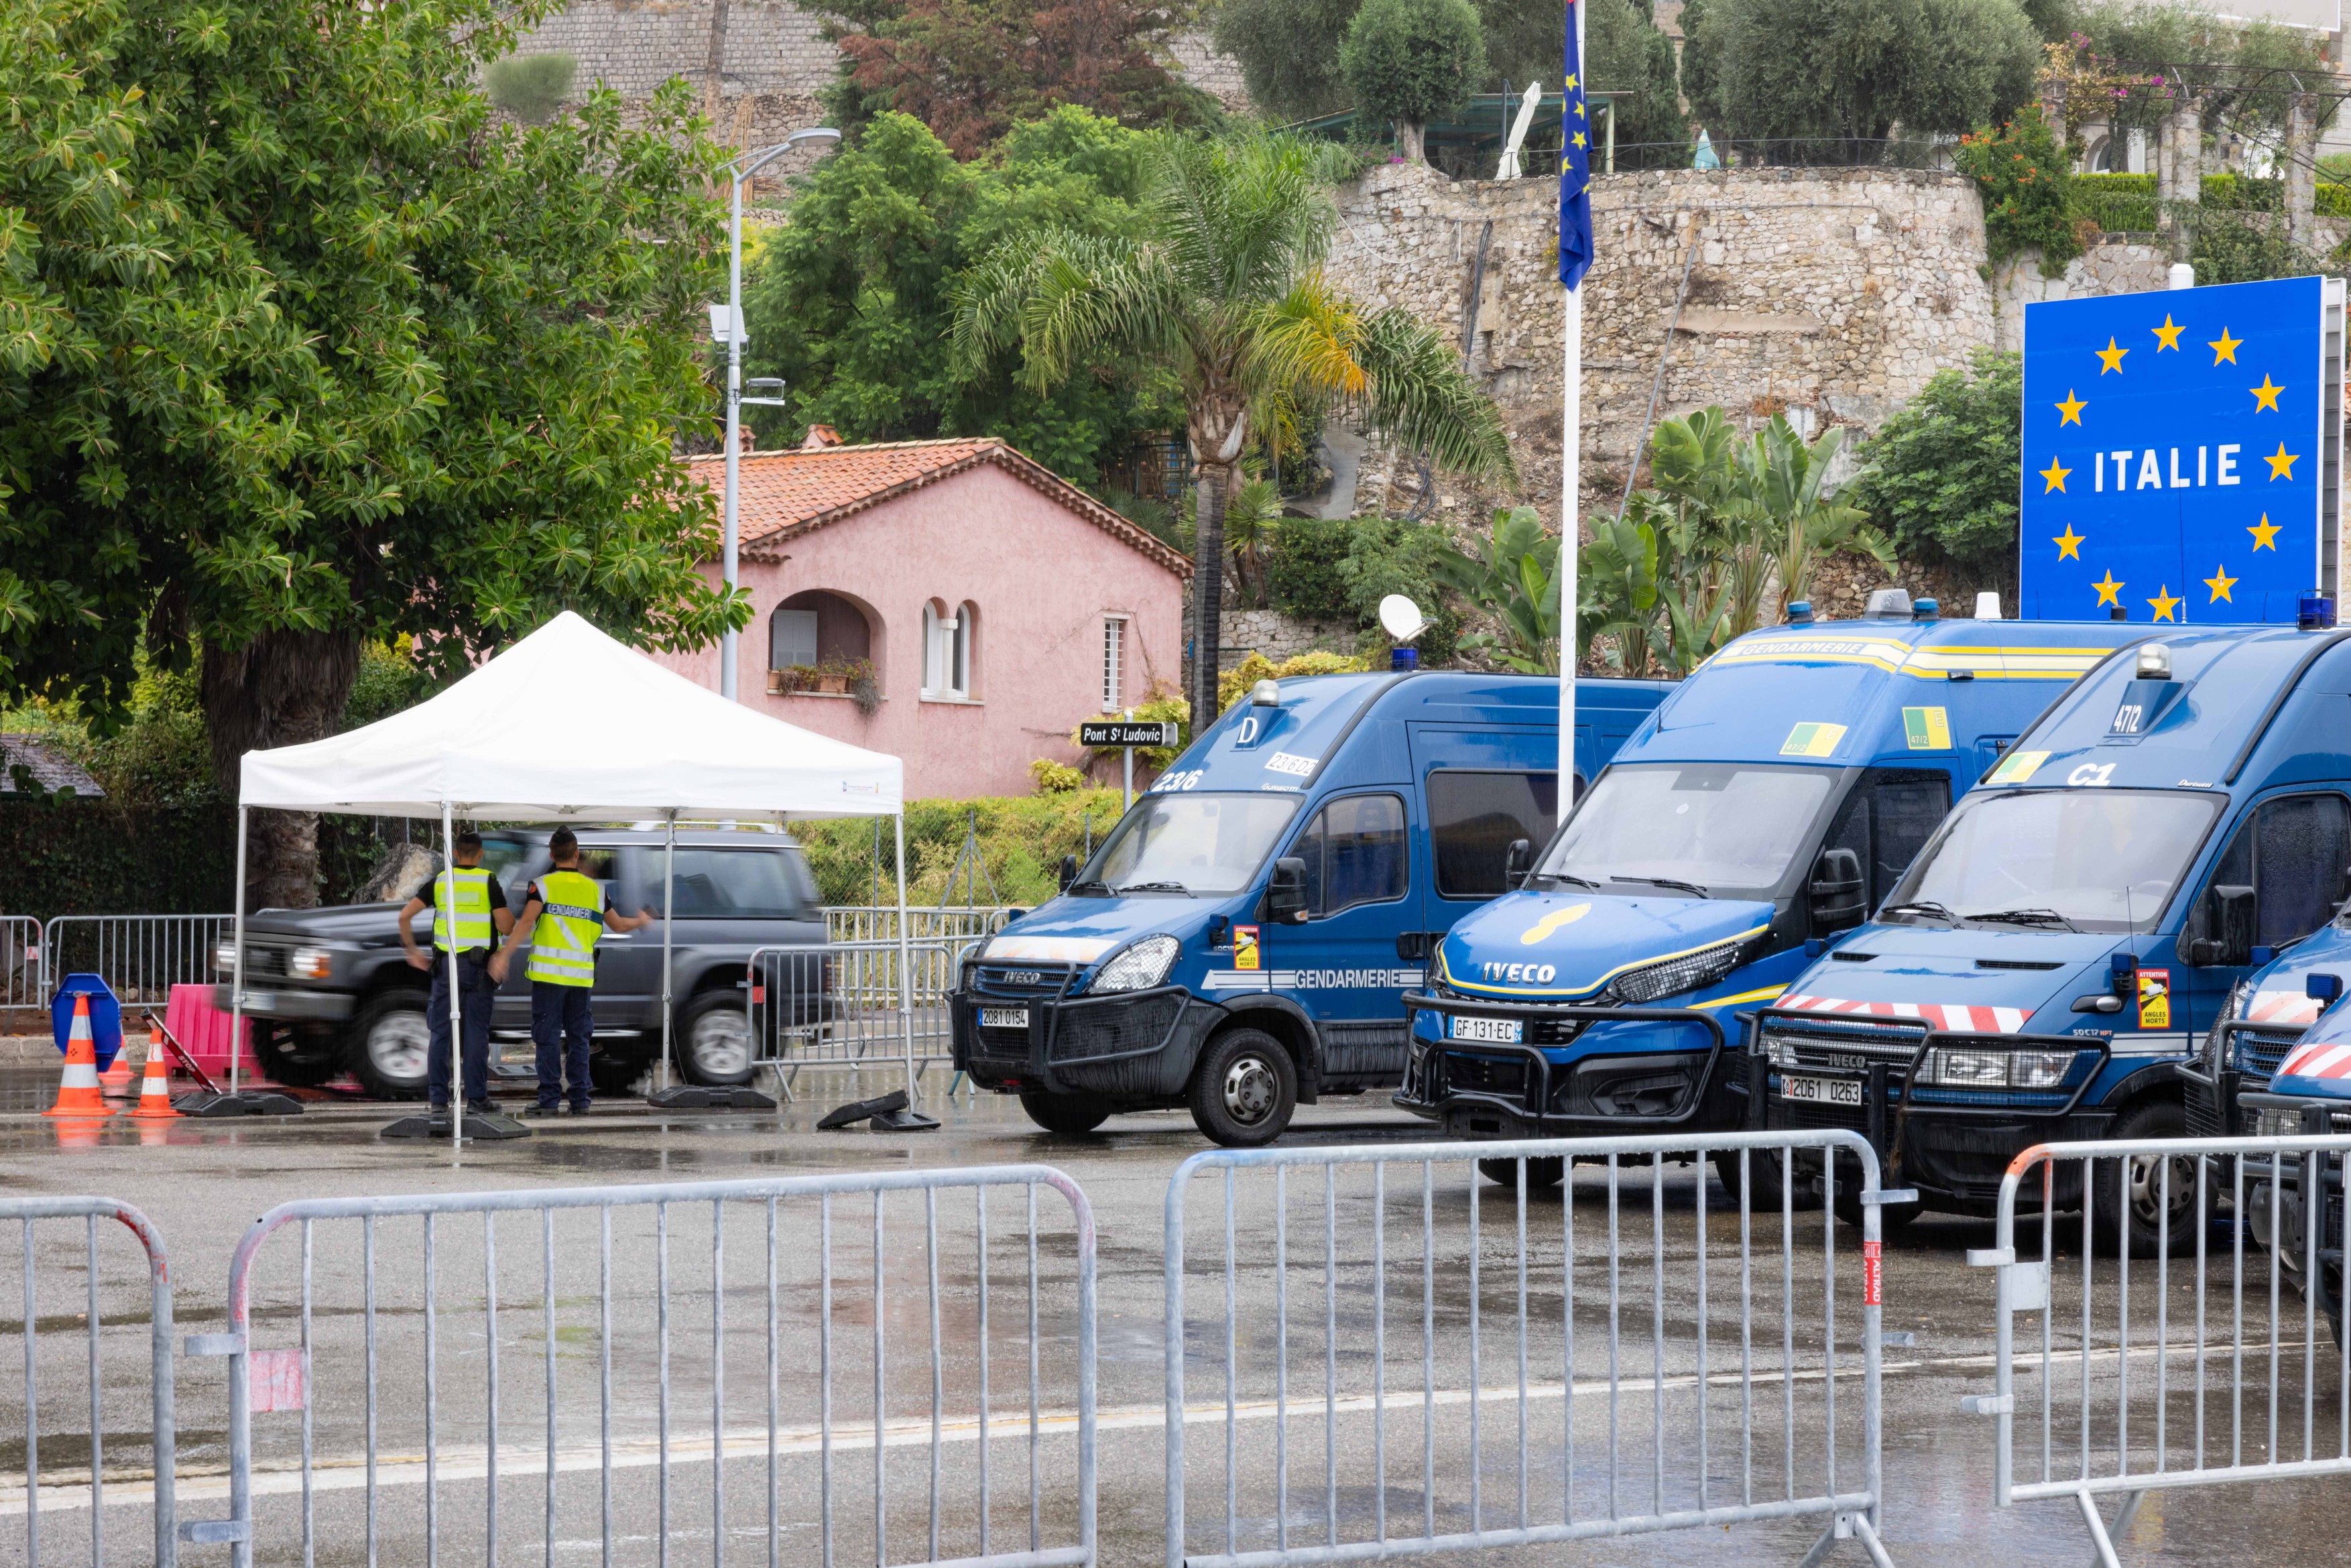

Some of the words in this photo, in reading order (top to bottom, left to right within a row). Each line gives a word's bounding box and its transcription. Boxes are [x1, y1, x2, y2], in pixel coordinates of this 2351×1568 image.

[2094, 443, 2241, 493] ITALIE
[1744, 642, 1863, 655] GENDARMERIE
[1934, 711, 1944, 727] E
[2114, 705, 2143, 733] 47/2
[1083, 727, 1107, 741] Pont
[1110, 727, 1121, 741] St
[1123, 727, 1160, 741] Ludovic
[1237, 717, 1258, 743] D
[1825, 727, 1840, 740] E
[1911, 735, 1929, 744] 47/2
[1786, 743, 1807, 751] 47/2
[1268, 754, 1299, 771] 23/6
[1294, 760, 1317, 774] D2
[1151, 770, 1204, 792] 23/6
[2067, 763, 2117, 786] C1
[1004, 971, 1040, 985] IVECO
[1295, 969, 1400, 989] GENDARMERIE
[1482, 962, 1556, 985] IVECO
[983, 1010, 1002, 1024] 2081
[1006, 1010, 1026, 1025] 0154
[1514, 1032, 1522, 1042] 24
[178, 1054, 196, 1073] STOP
[1828, 1053, 1866, 1068] IVECO
[1793, 1079, 1821, 1099] 2061
[1830, 1081, 1859, 1103] 0263
[1872, 1260, 1880, 1302] ALTRAD
